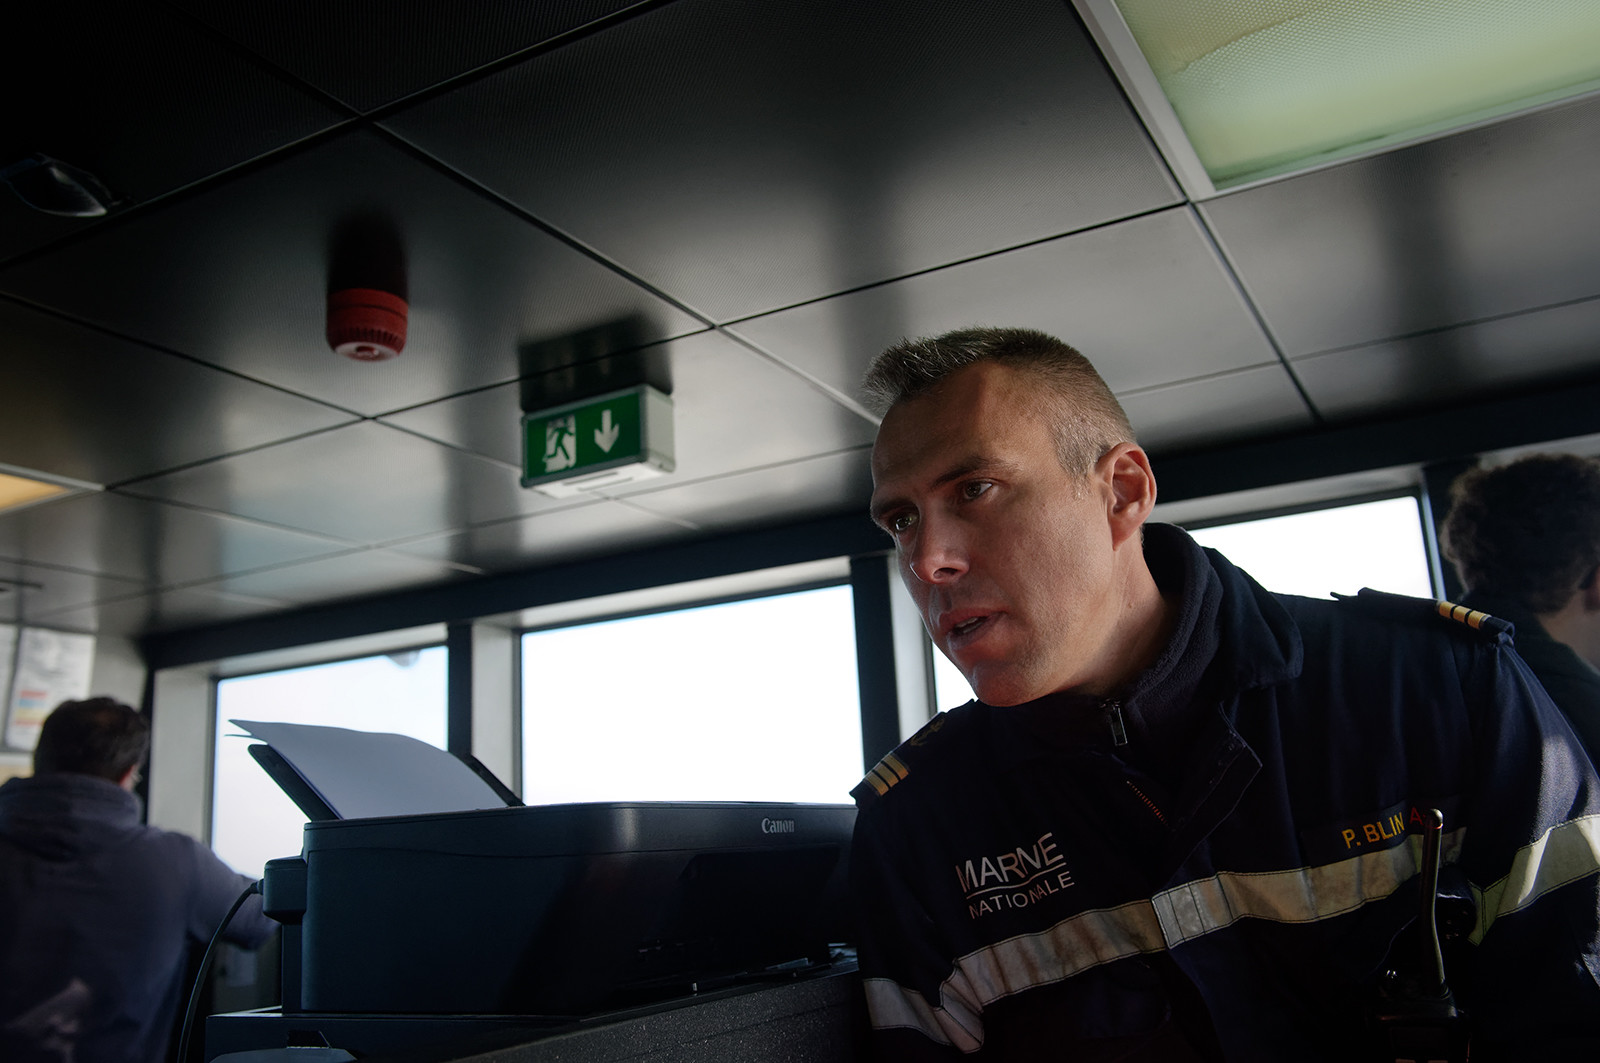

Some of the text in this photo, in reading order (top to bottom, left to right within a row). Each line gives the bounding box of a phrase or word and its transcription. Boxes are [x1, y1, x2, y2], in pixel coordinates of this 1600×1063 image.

[761, 817, 795, 834] Canon
[1341, 828, 1362, 849] P.
[1363, 812, 1406, 844] BLIN
[968, 870, 1076, 920] NATIONALE
